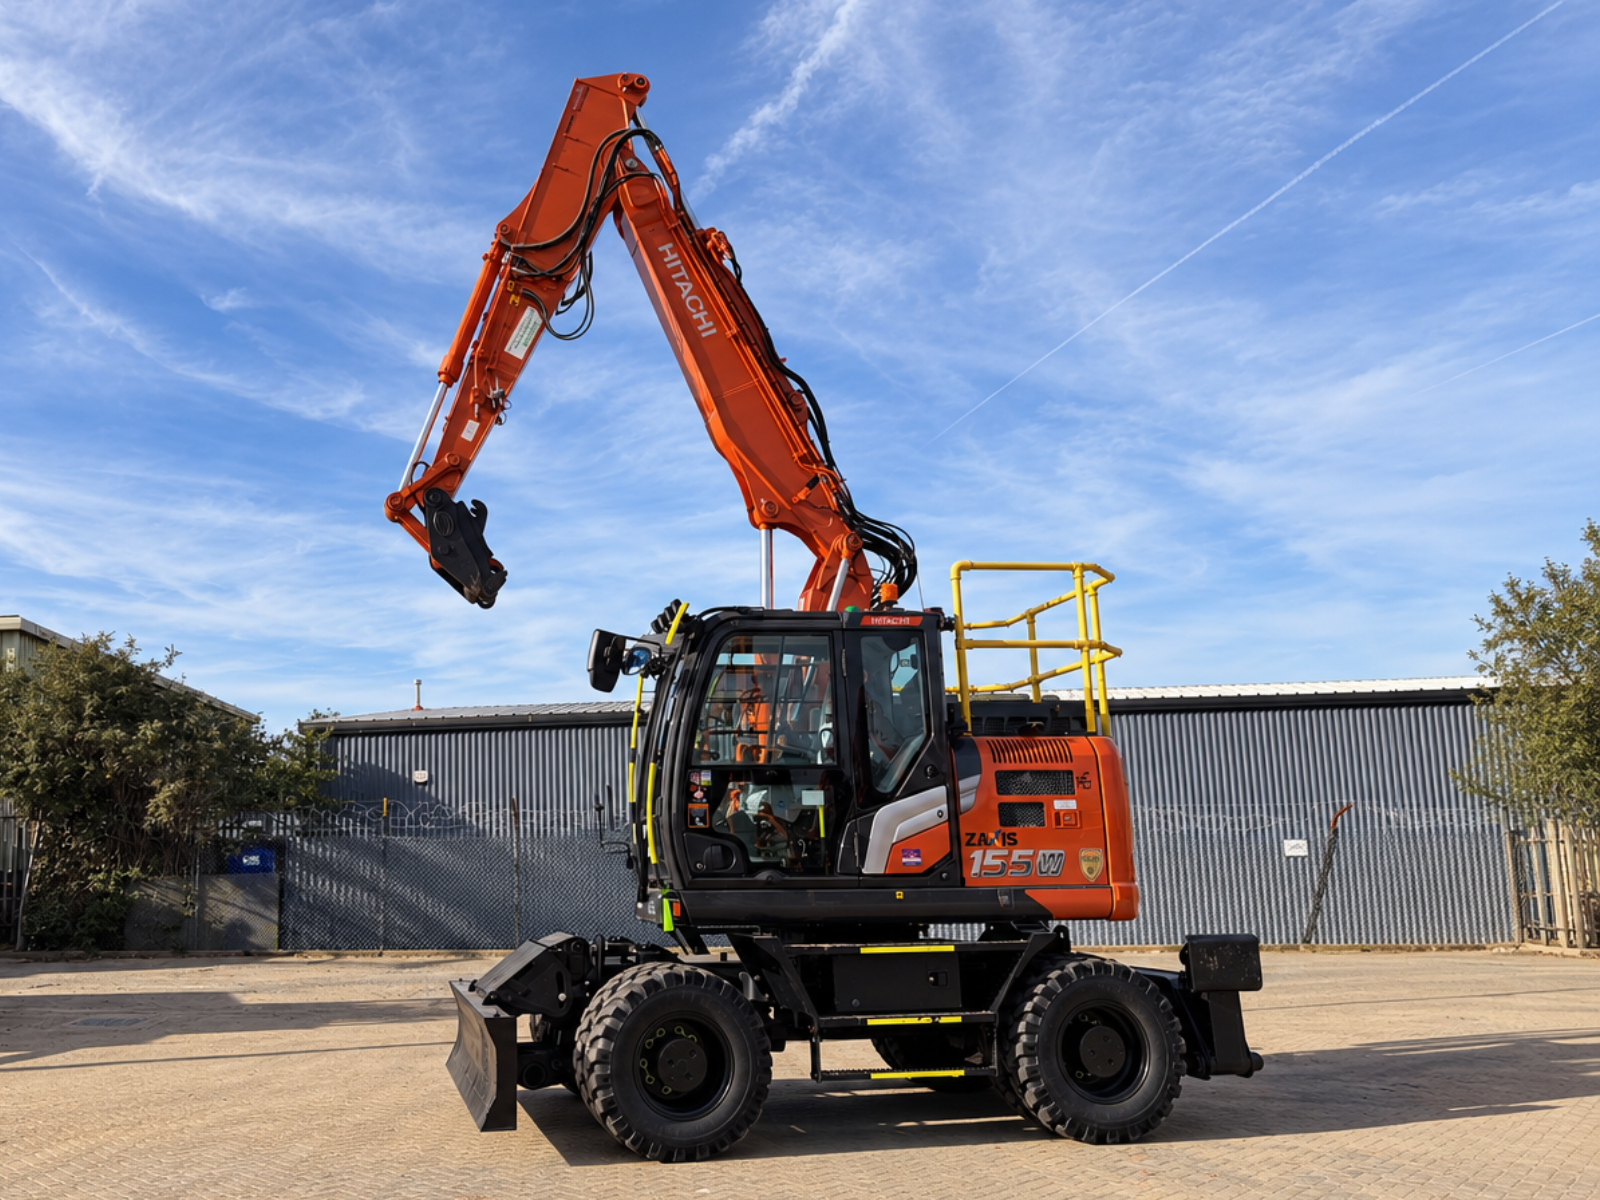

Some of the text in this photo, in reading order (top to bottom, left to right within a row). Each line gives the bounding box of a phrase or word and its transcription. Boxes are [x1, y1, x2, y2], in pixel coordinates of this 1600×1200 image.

[658, 242, 717, 338] HITACHI
[871, 616, 910, 625] HITACHI
[965, 829, 1018, 847] ZAXIS
[970, 849, 1065, 878] 155W
